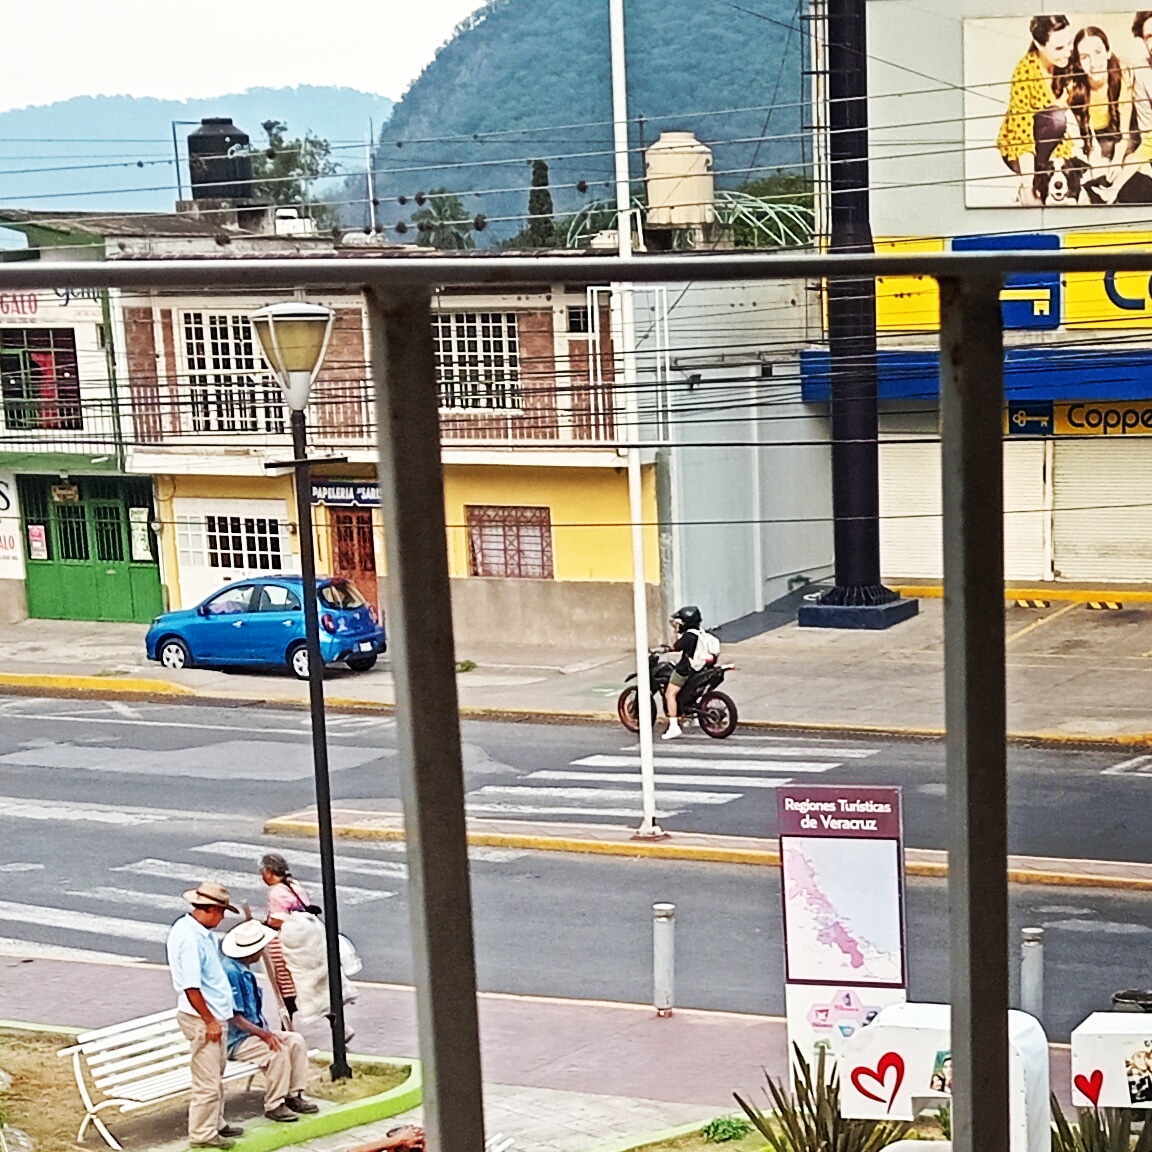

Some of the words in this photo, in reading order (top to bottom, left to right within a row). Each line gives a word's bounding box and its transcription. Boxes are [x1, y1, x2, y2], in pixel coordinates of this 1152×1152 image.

[784, 798, 836, 814] Regiones
[837, 798, 892, 813] Turísticas
[800, 813, 818, 829] de
[819, 814, 878, 830] Veracruz
